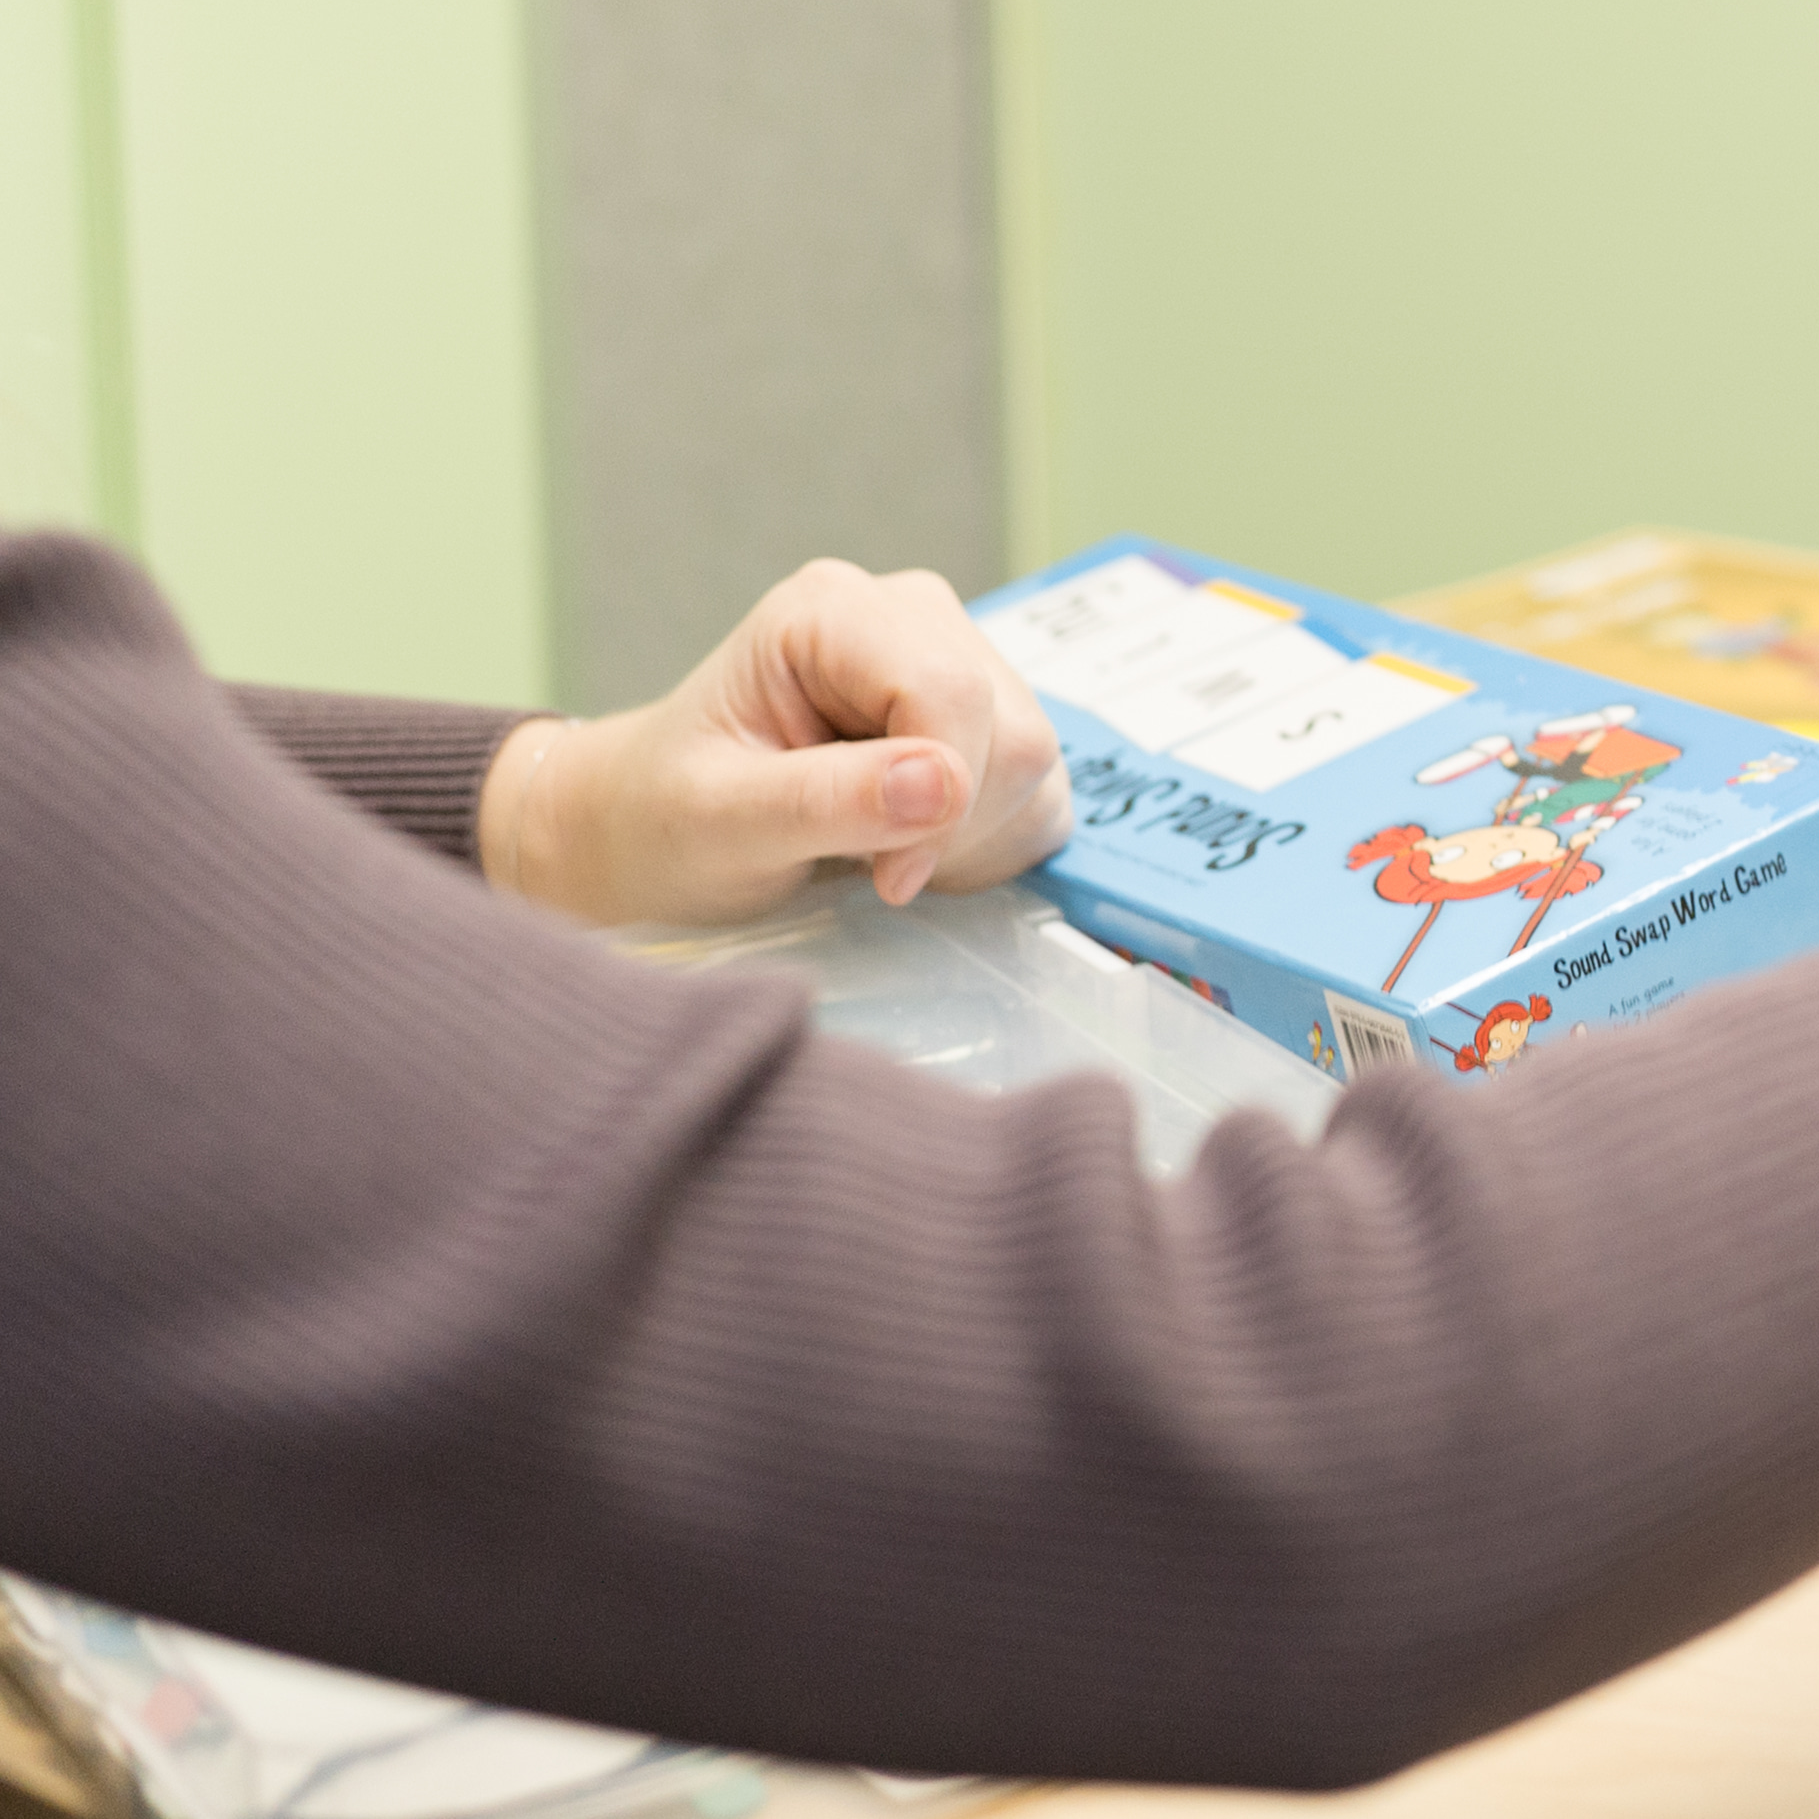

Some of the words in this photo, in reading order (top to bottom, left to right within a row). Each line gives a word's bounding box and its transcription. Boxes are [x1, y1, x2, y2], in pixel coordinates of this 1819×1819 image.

[1277, 710, 1345, 742] s
[1134, 793, 1307, 872] Sound
[1553, 939, 1615, 990] Sound
[1614, 914, 1671, 958] Swap
[1670, 878, 1733, 926] Word
[1733, 852, 1788, 895] Game
[1608, 1002, 1619, 1019] A
[1620, 995, 1640, 1016] fun
[1643, 976, 1675, 1002] game
